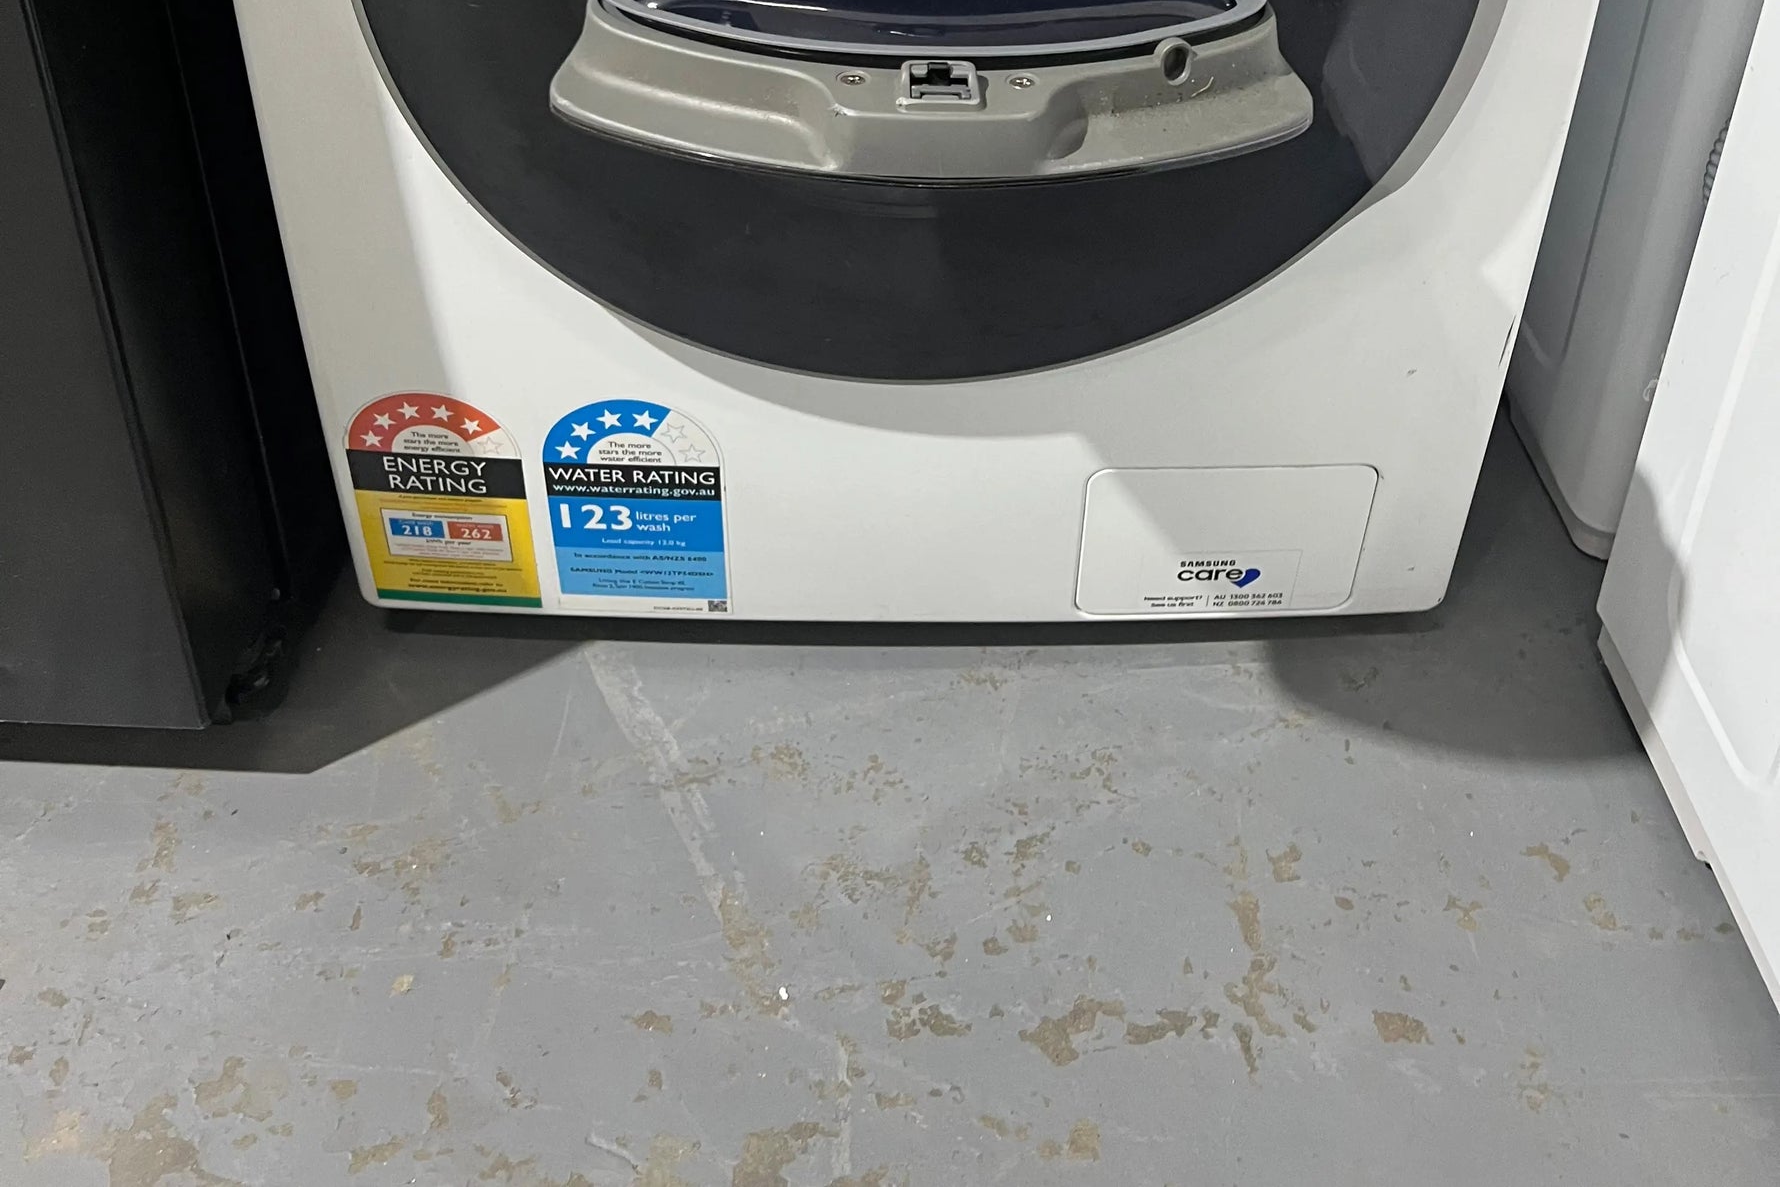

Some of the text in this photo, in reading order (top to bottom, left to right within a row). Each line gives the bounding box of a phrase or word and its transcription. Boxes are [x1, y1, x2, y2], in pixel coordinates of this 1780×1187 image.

[608, 441, 625, 449] The
[628, 455, 662, 463] efficient
[382, 455, 486, 476] ENERGY
[549, 467, 715, 485] WATER RATING
[388, 474, 487, 494] RATING
[553, 484, 715, 497] www.waterrating.gov.au
[560, 503, 697, 531] 123 litres per
[401, 525, 433, 536] 218
[461, 528, 492, 539] 262
[636, 523, 671, 532] wash
[1180, 559, 1236, 567] SAMSUNG
[1177, 568, 1243, 582] care
